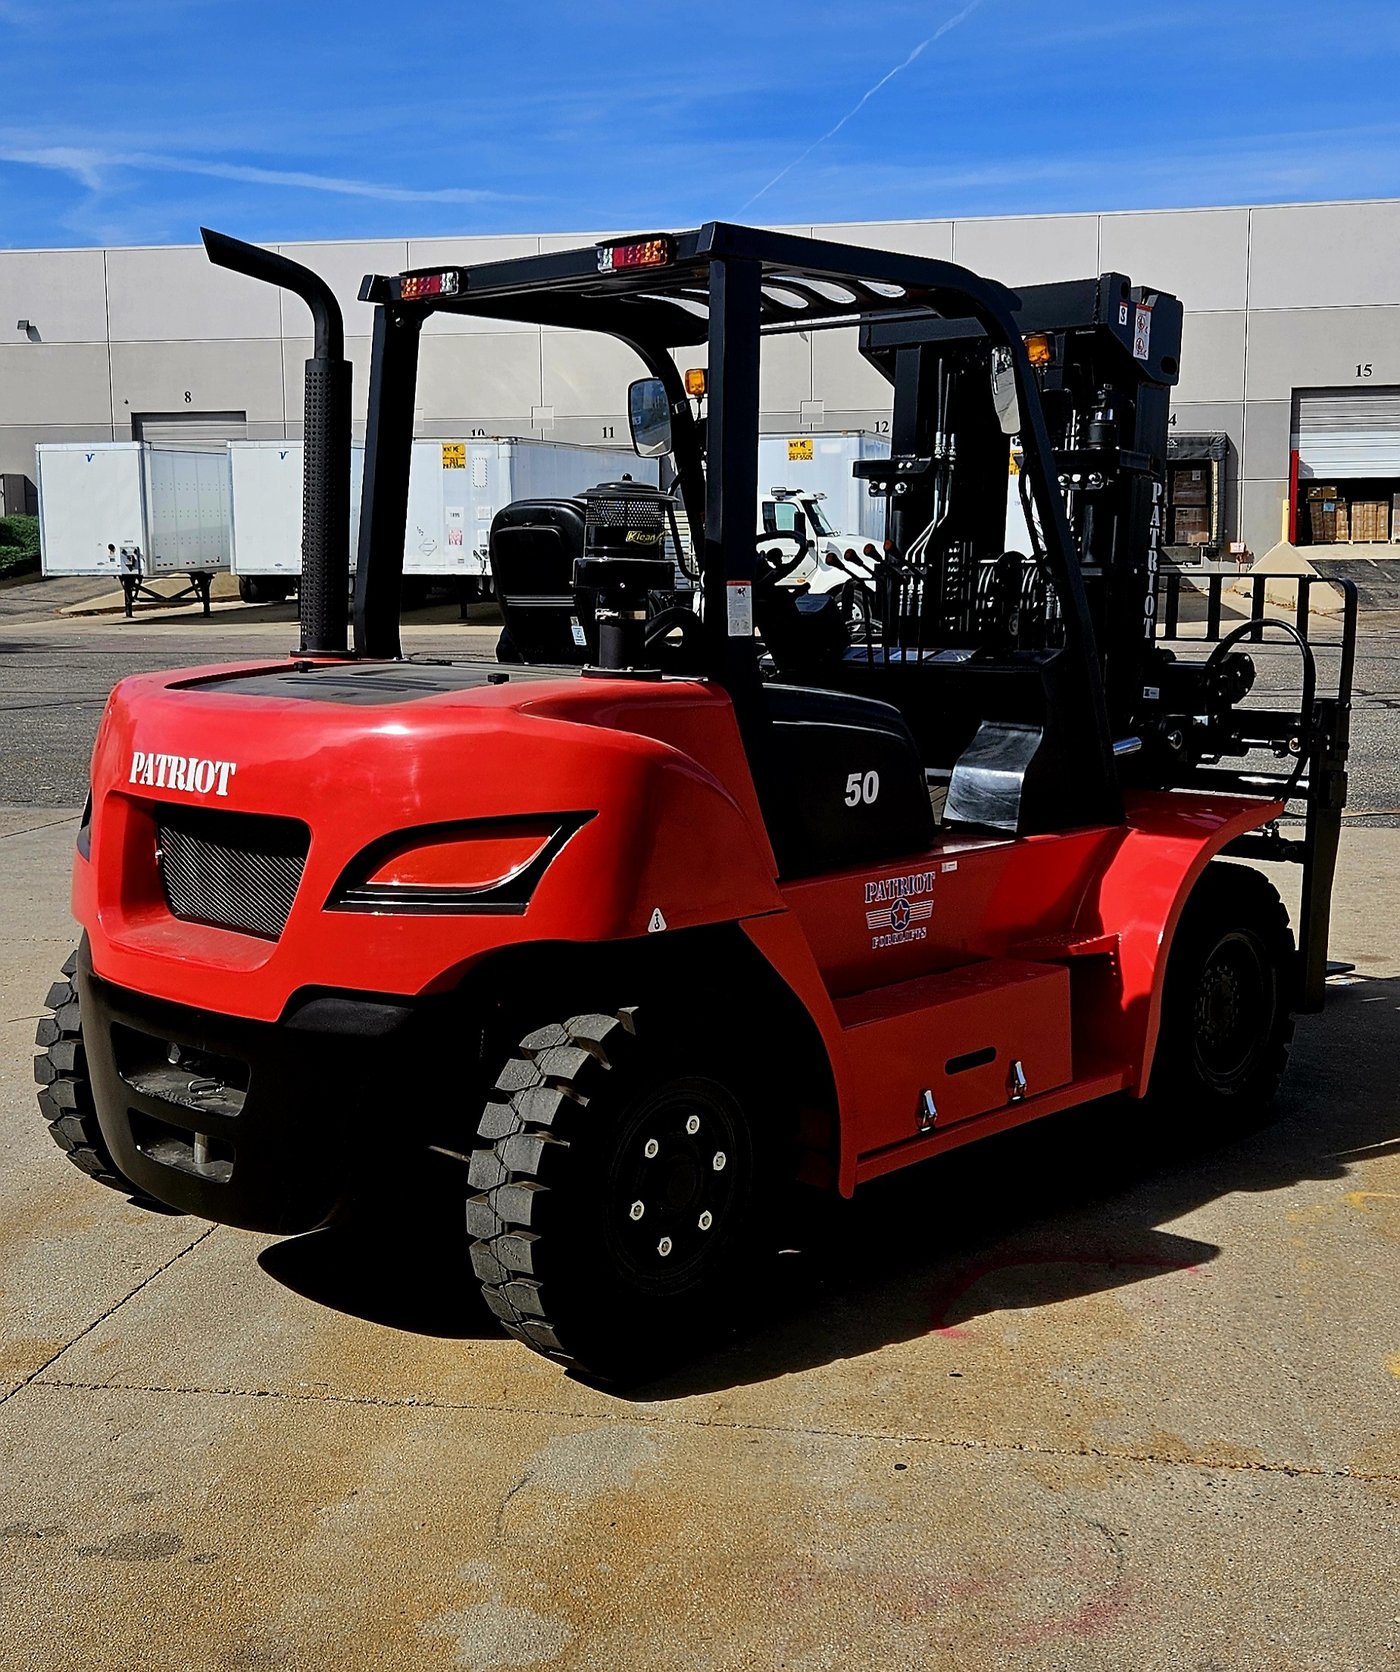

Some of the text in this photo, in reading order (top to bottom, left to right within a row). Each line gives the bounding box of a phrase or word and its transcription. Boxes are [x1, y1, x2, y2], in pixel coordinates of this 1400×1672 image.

[1355, 363, 1373, 377] 15
[184, 390, 192, 404] 8
[602, 426, 615, 439] 11
[874, 421, 889, 434] 12
[1144, 481, 1163, 639] PATRIOT
[129, 752, 236, 796] PATRIOT
[844, 769, 880, 807] 50
[864, 871, 936, 903] PATRIOT
[871, 926, 928, 949] FORKLIFTS
